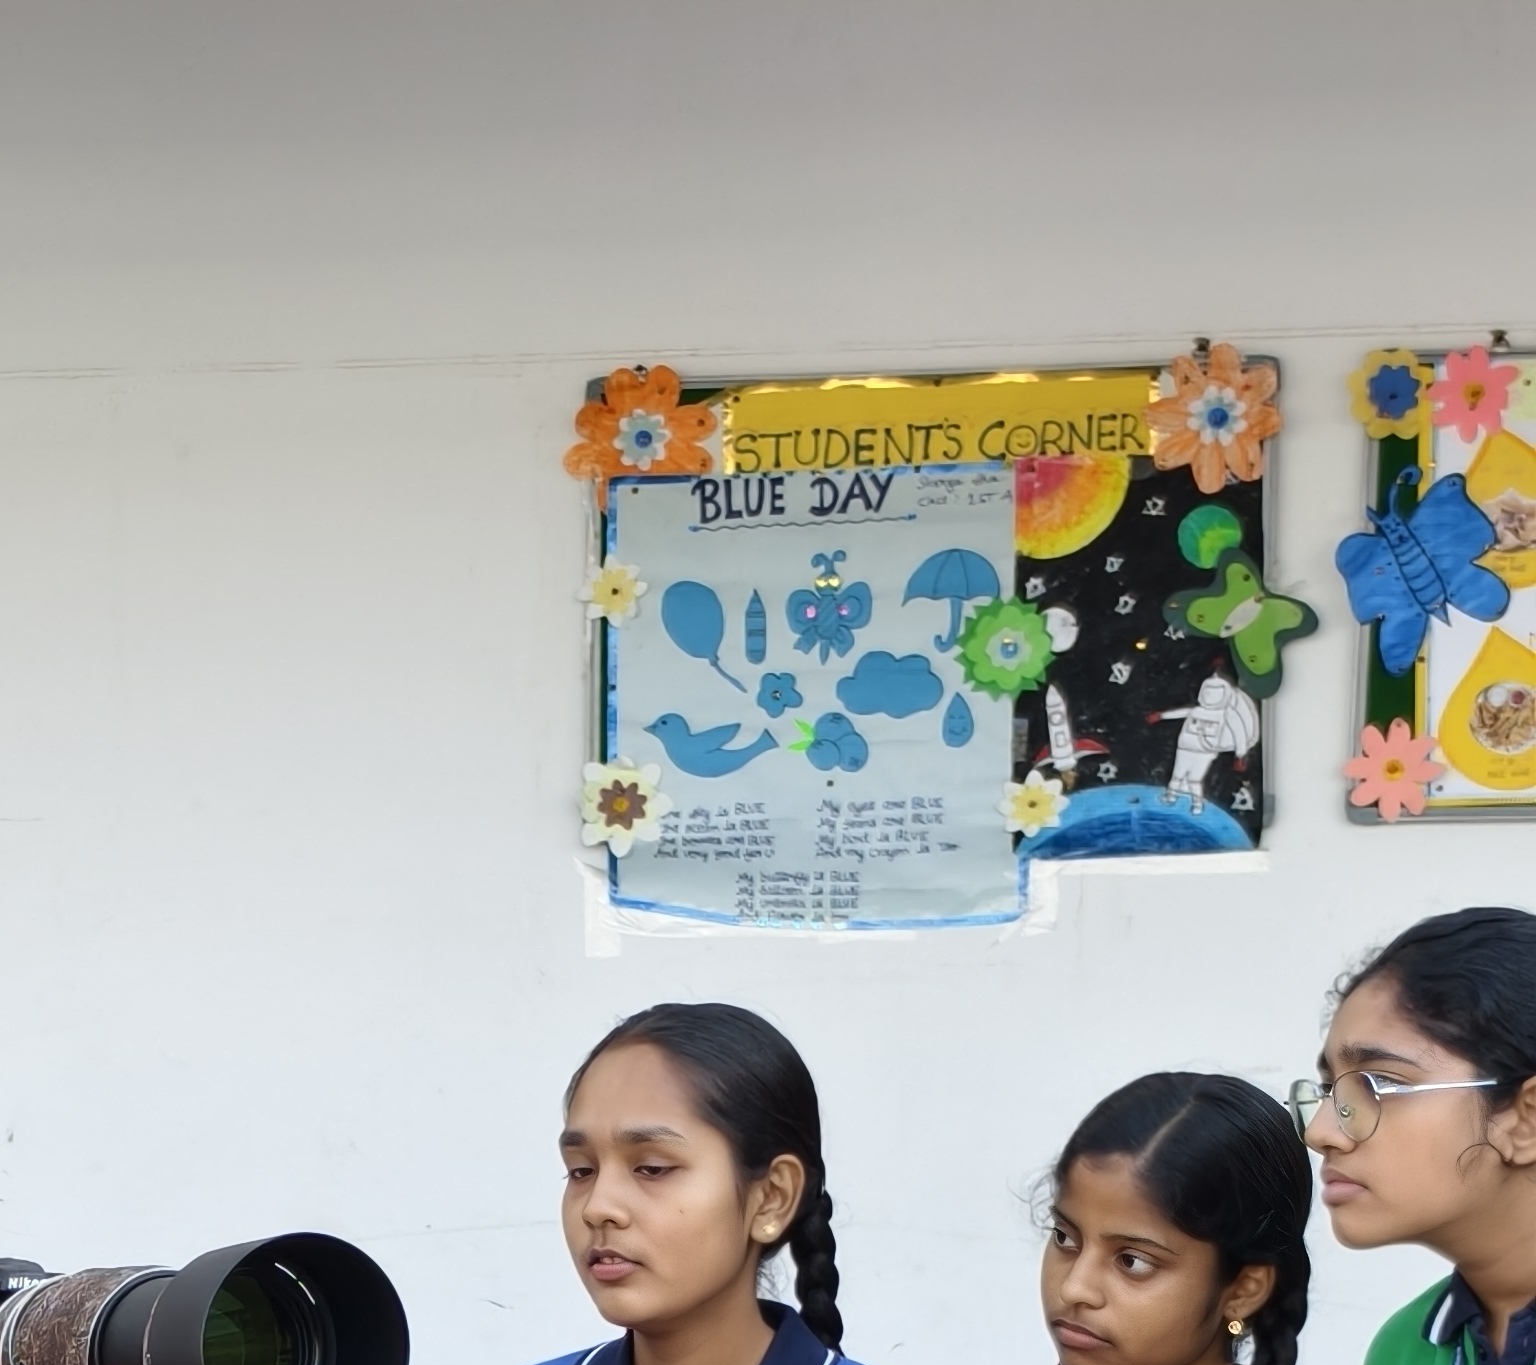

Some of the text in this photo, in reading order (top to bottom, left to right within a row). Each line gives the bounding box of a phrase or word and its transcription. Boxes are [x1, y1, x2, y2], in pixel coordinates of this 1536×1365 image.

[732, 413, 1145, 474] STUDENT'S CORNER
[690, 476, 785, 524] BLUE
[809, 472, 894, 516] DAY
